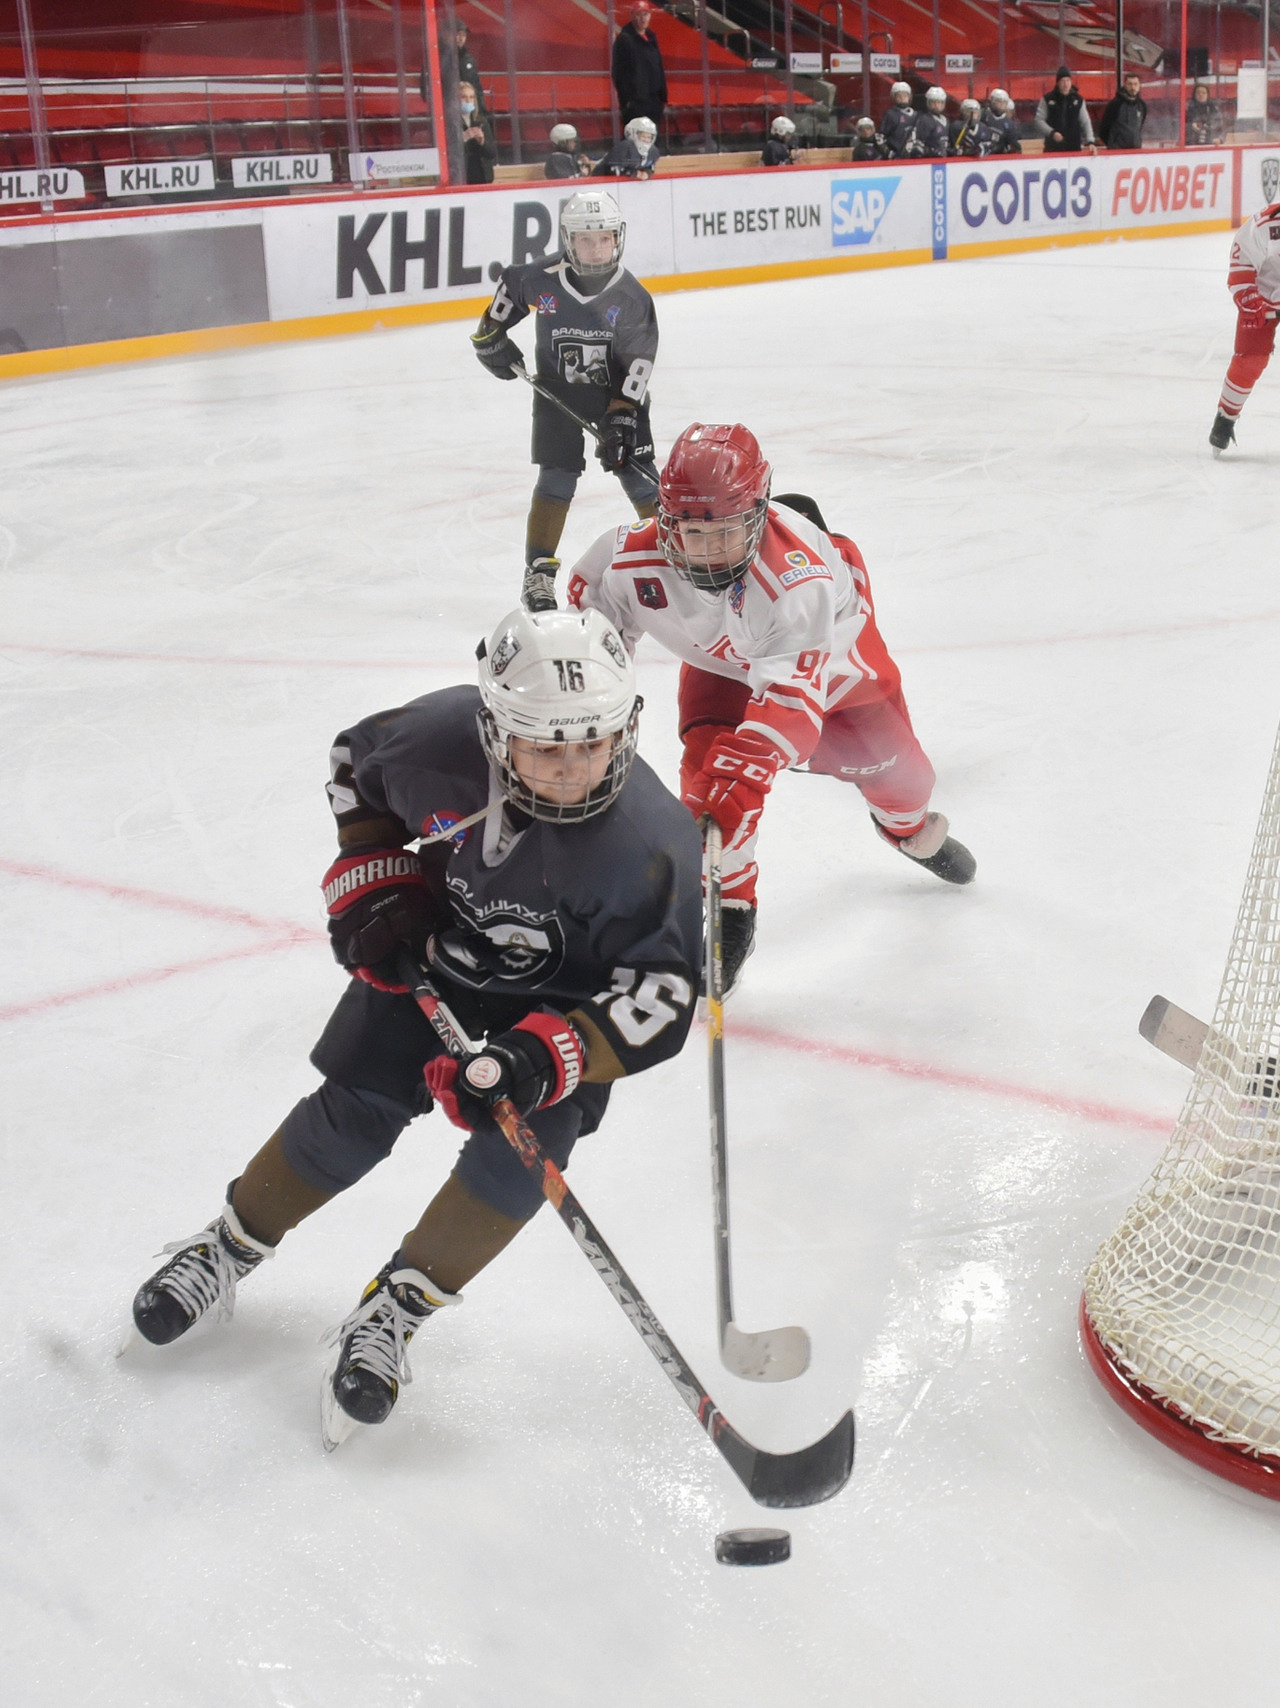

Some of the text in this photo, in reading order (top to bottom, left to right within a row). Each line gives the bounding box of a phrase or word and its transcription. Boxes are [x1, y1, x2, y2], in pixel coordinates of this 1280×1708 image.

[120, 165, 200, 191] KHL.RU
[246, 159, 319, 182] KHL.RU
[0, 172, 68, 198] HL.RU
[1111, 163, 1225, 217] FONBET
[689, 204, 821, 237] THE BEST RUN
[832, 189, 886, 236] SAP
[336, 199, 571, 299] KHL.R
[782, 566, 830, 583] ERIELL
[552, 660, 585, 693] 16
[548, 714, 601, 727] BAUER
[840, 754, 898, 775] CCM
[325, 856, 422, 909] WARRIOR
[370, 893, 400, 913] COVERT
